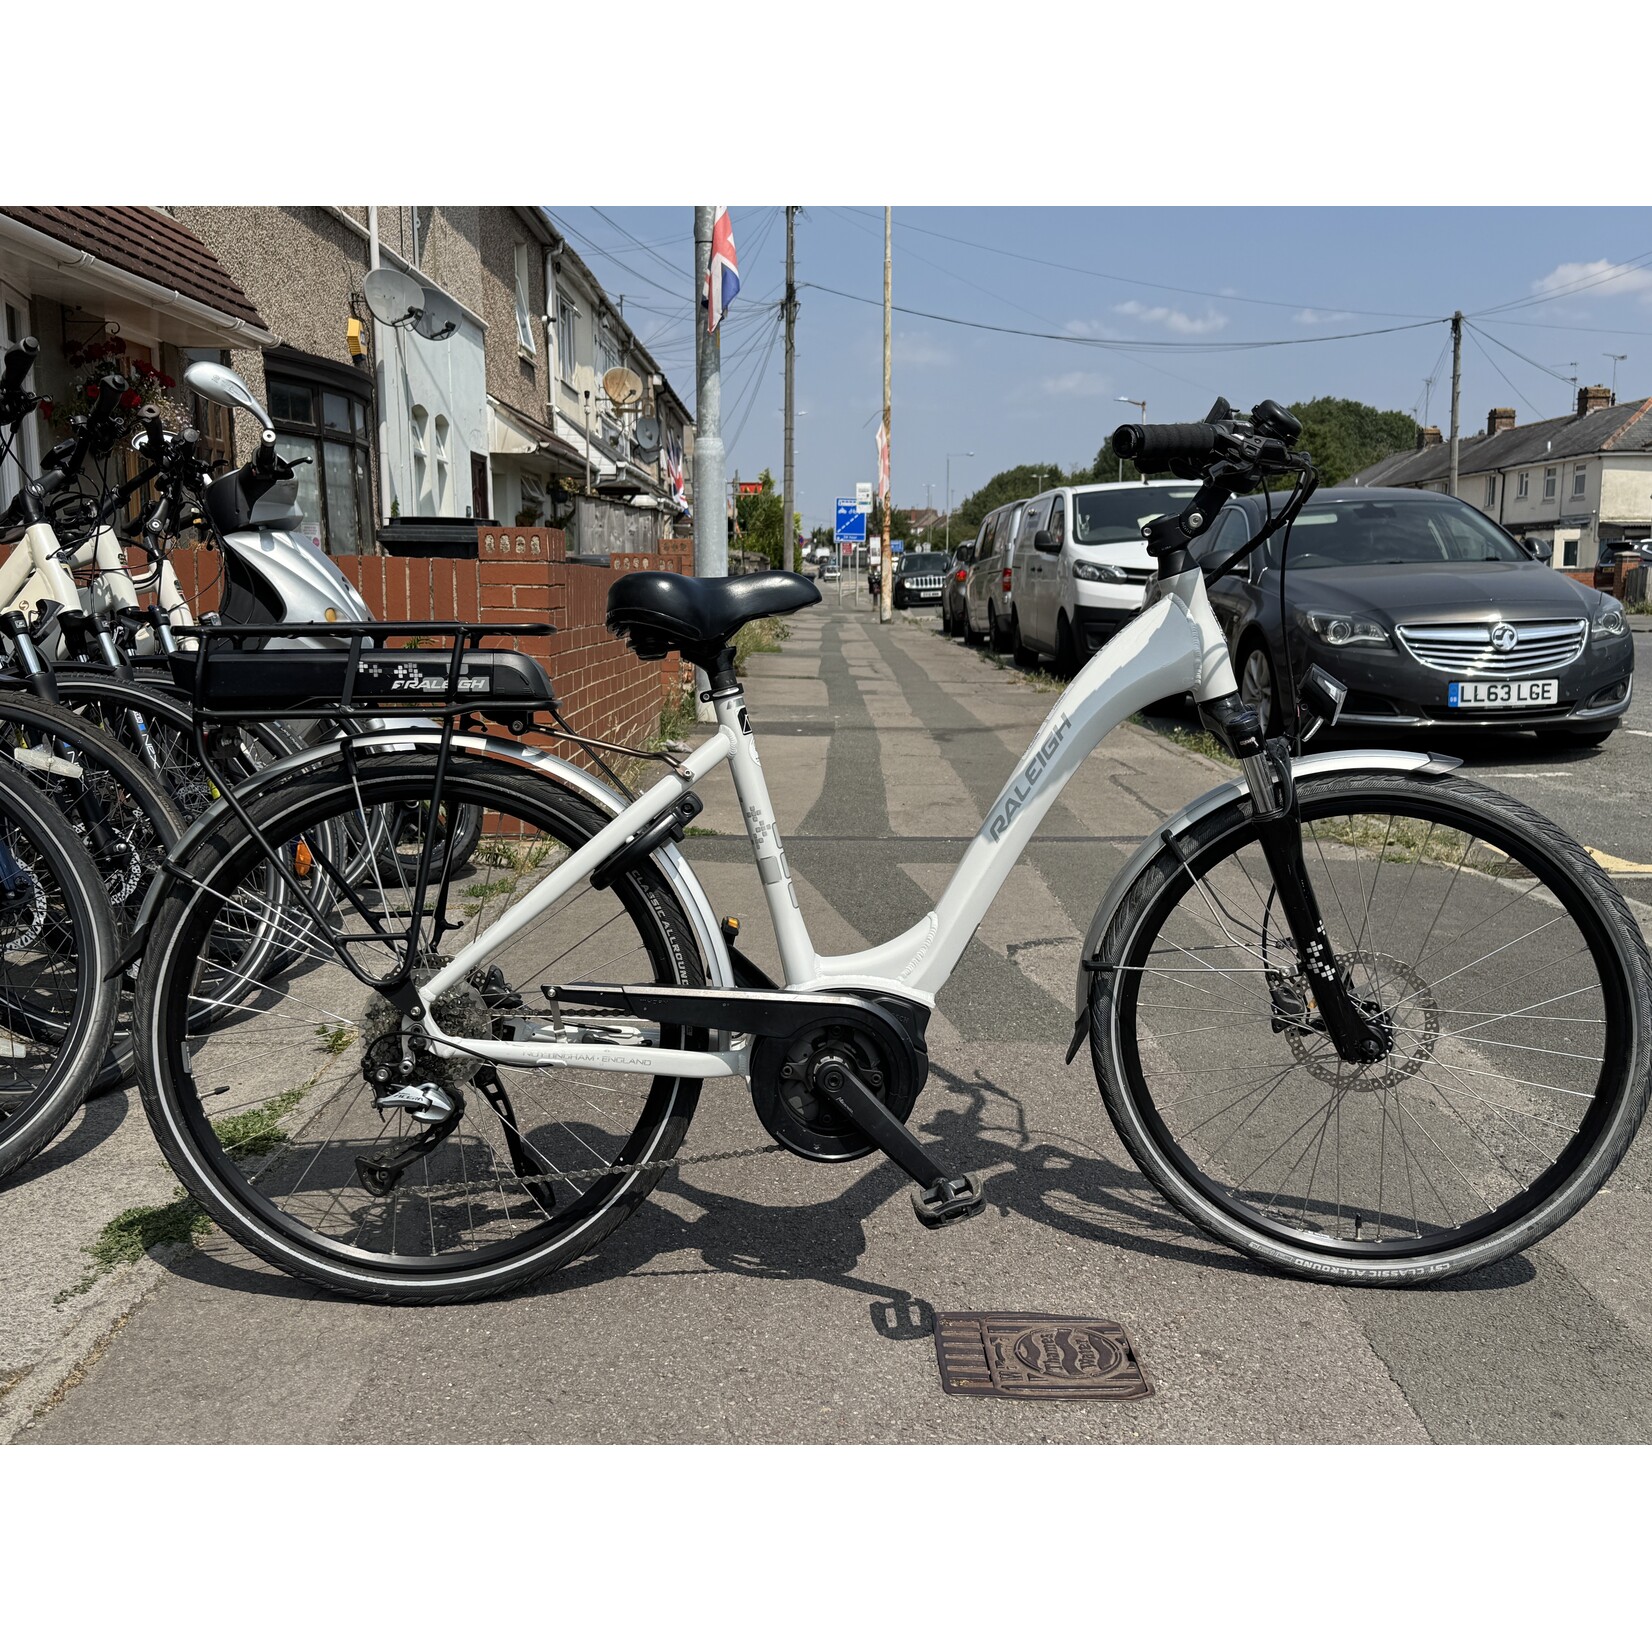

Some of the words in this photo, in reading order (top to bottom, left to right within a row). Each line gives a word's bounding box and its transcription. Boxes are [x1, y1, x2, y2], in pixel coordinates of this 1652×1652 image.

[403, 679, 486, 690] RALEGH
[1460, 684, 1512, 703] LL63
[1517, 683, 1552, 702] LGE
[989, 712, 1072, 844] RALEIGH
[631, 869, 665, 918] CLASSIC
[601, 1055, 652, 1066] ENGLAND
[1294, 1258, 1366, 1277] ALLROUND
[1365, 1266, 1427, 1277] CLASSIC
[1428, 1263, 1450, 1273] CST
[1040, 1333, 1063, 1371] Thames
[1075, 1338, 1097, 1371] Water
